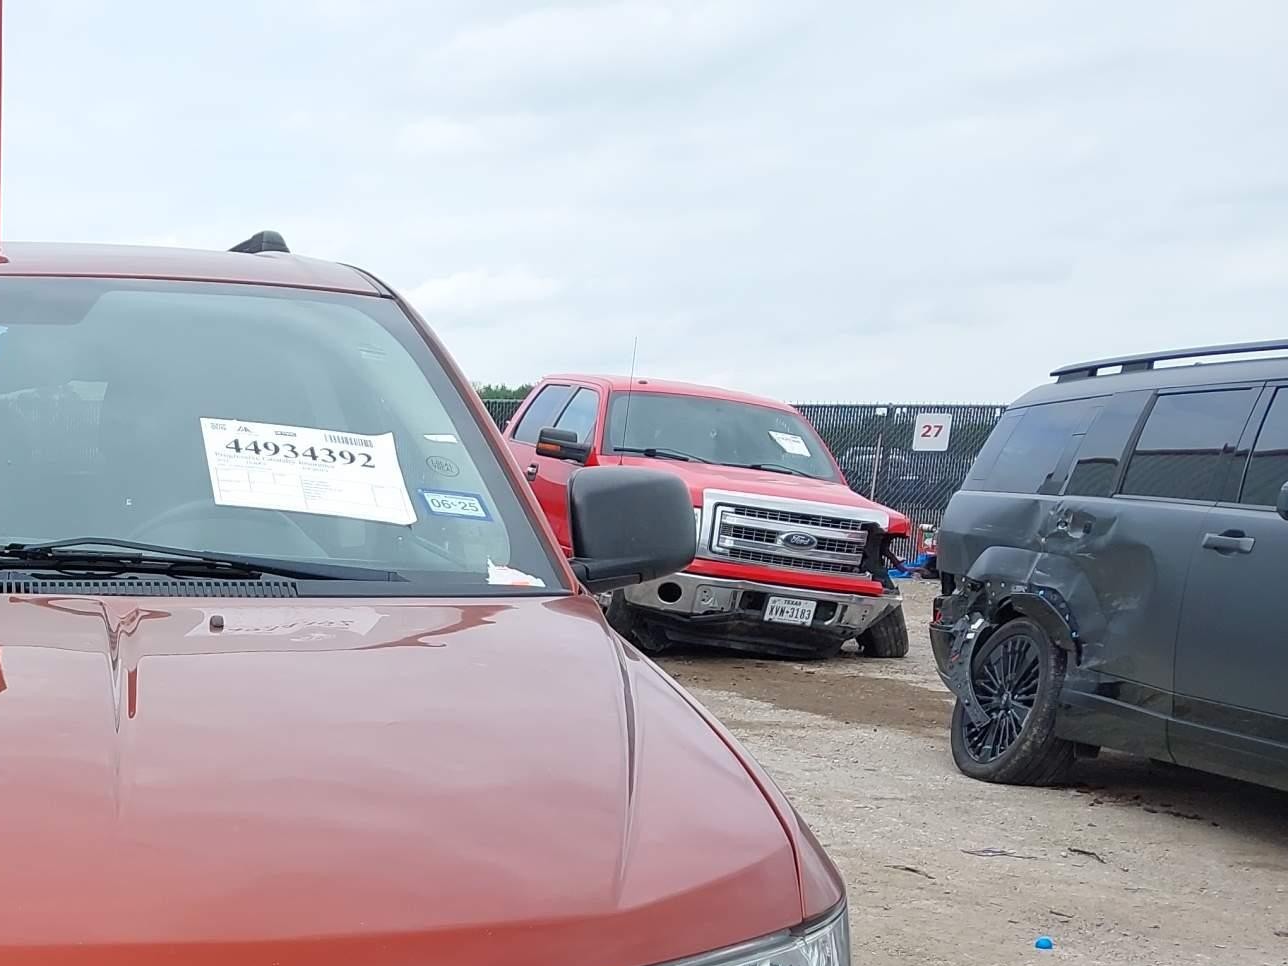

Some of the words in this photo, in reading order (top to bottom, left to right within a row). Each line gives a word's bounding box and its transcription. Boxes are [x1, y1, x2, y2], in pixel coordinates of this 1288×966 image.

[920, 424, 944, 438] 27
[225, 438, 376, 469] 44934392
[791, 534, 811, 545] Ford
